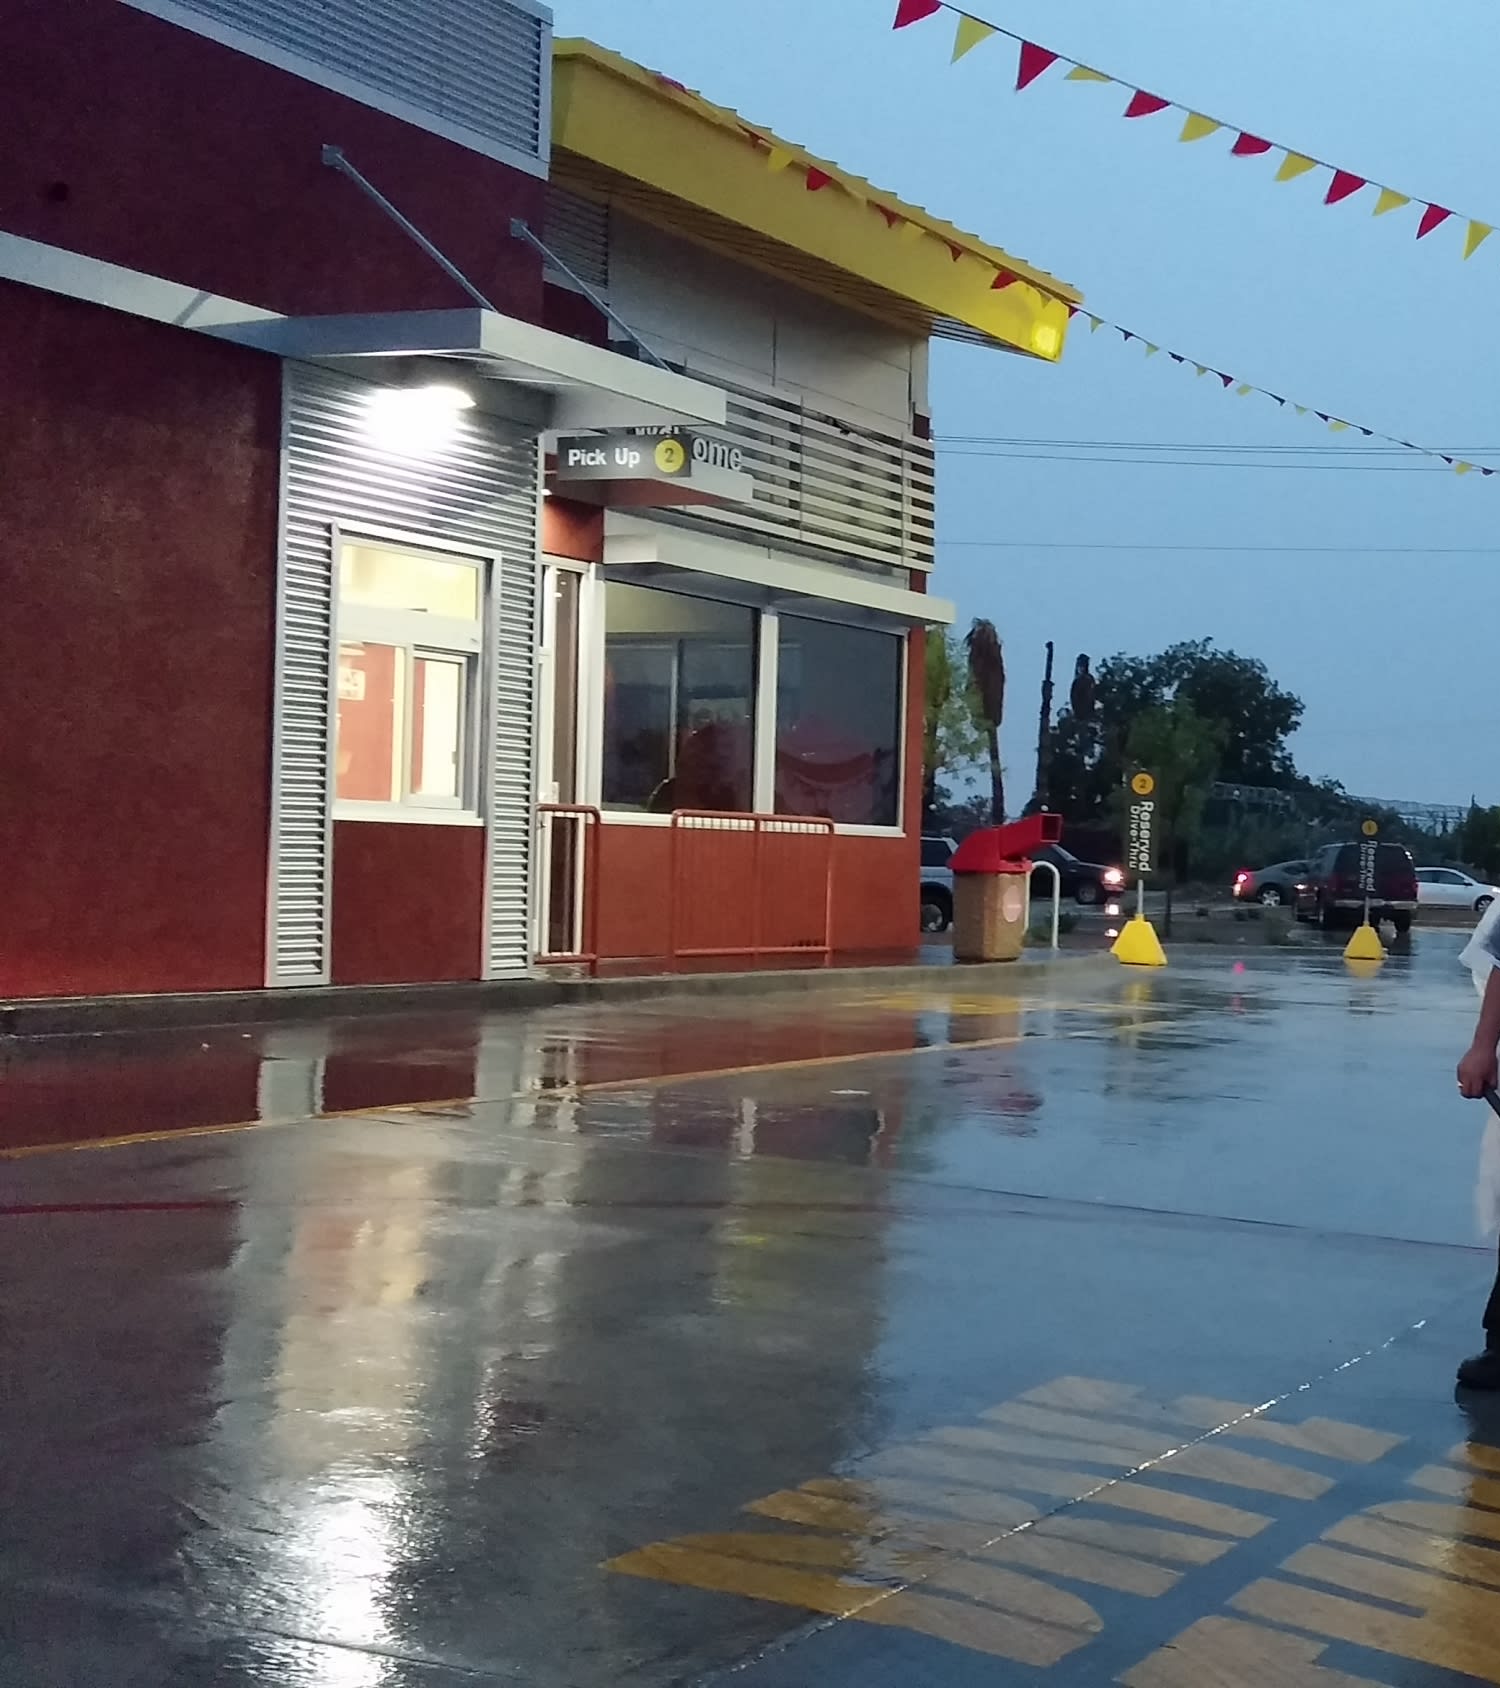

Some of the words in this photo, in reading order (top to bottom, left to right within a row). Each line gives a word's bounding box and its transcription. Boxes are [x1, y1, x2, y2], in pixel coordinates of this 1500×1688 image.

[568, 449, 607, 467] Pick
[614, 448, 641, 469] Up
[1129, 805, 1140, 869] Drive-Thru
[1139, 801, 1154, 872] Reserved
